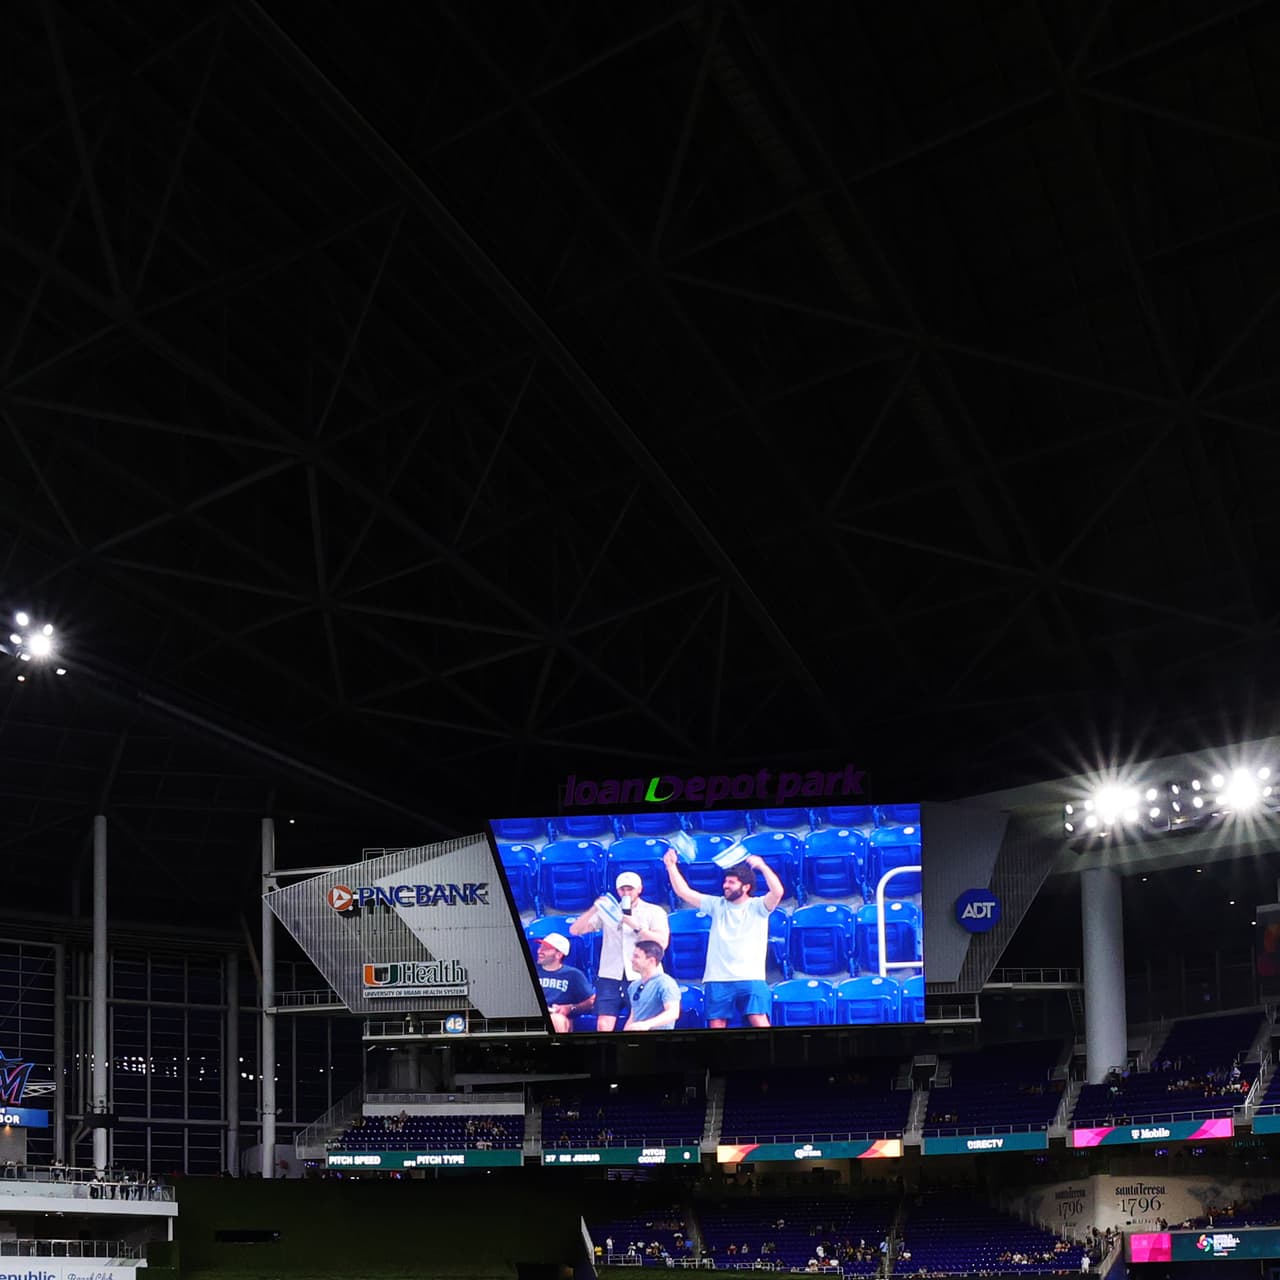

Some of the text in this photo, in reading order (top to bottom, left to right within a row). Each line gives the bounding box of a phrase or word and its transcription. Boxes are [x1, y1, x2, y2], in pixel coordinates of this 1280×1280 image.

[563, 763, 865, 808] loanDepot park
[960, 902, 996, 918] ADT
[447, 1018, 464, 1029] 42
[1141, 1128, 1170, 1139] Mobile
[967, 1139, 1004, 1150] DIRECTV
[328, 1155, 381, 1165] PITCH SPEED
[416, 1154, 465, 1164] PITCH TYPE
